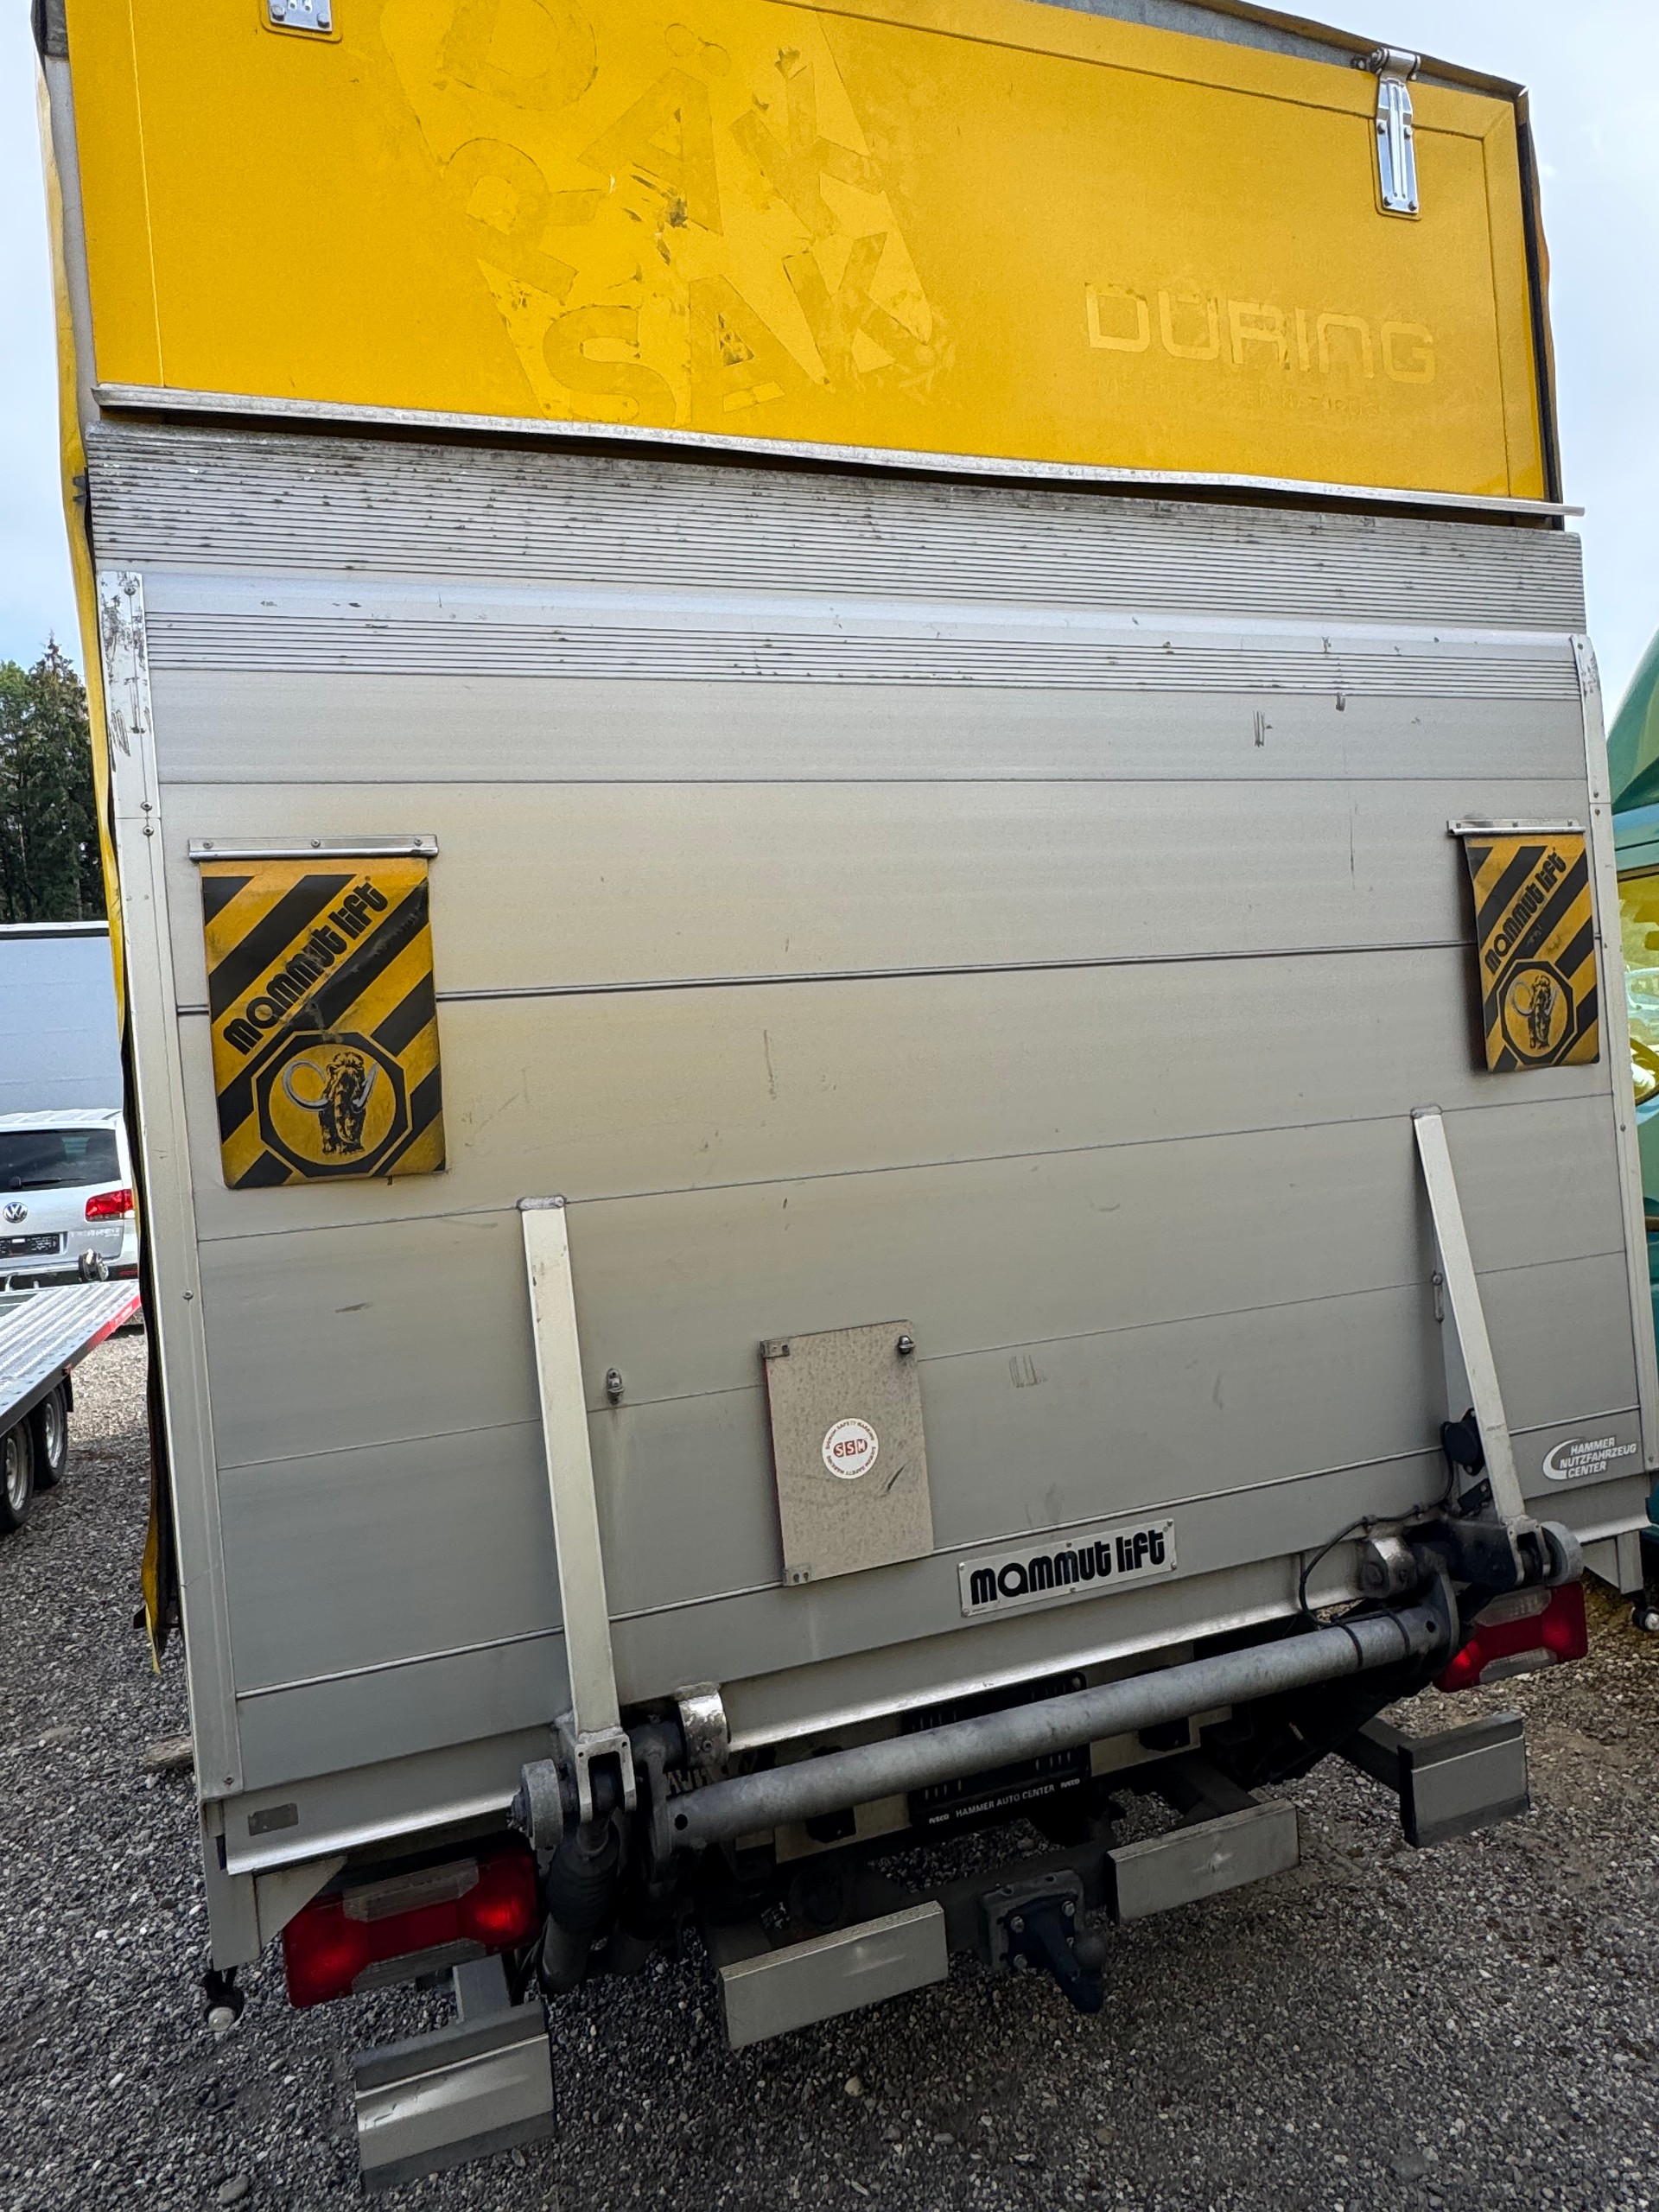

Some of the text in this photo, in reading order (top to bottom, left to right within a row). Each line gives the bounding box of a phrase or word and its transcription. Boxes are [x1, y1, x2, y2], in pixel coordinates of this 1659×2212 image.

[1484, 852, 1567, 975] mammut lift
[223, 881, 389, 1056] mammut lift
[835, 1440, 866, 1457] SSM
[1560, 1444, 1637, 1470] NUTZFAHRZEUG
[1570, 1436, 1615, 1456] HAMMER
[1567, 1460, 1606, 1478] CENTER
[969, 1529, 1166, 1605] mammut lift
[956, 1800, 995, 1818] HAMMER
[996, 1792, 1020, 1807] AUTO
[1022, 1783, 1055, 1800] CENTER
